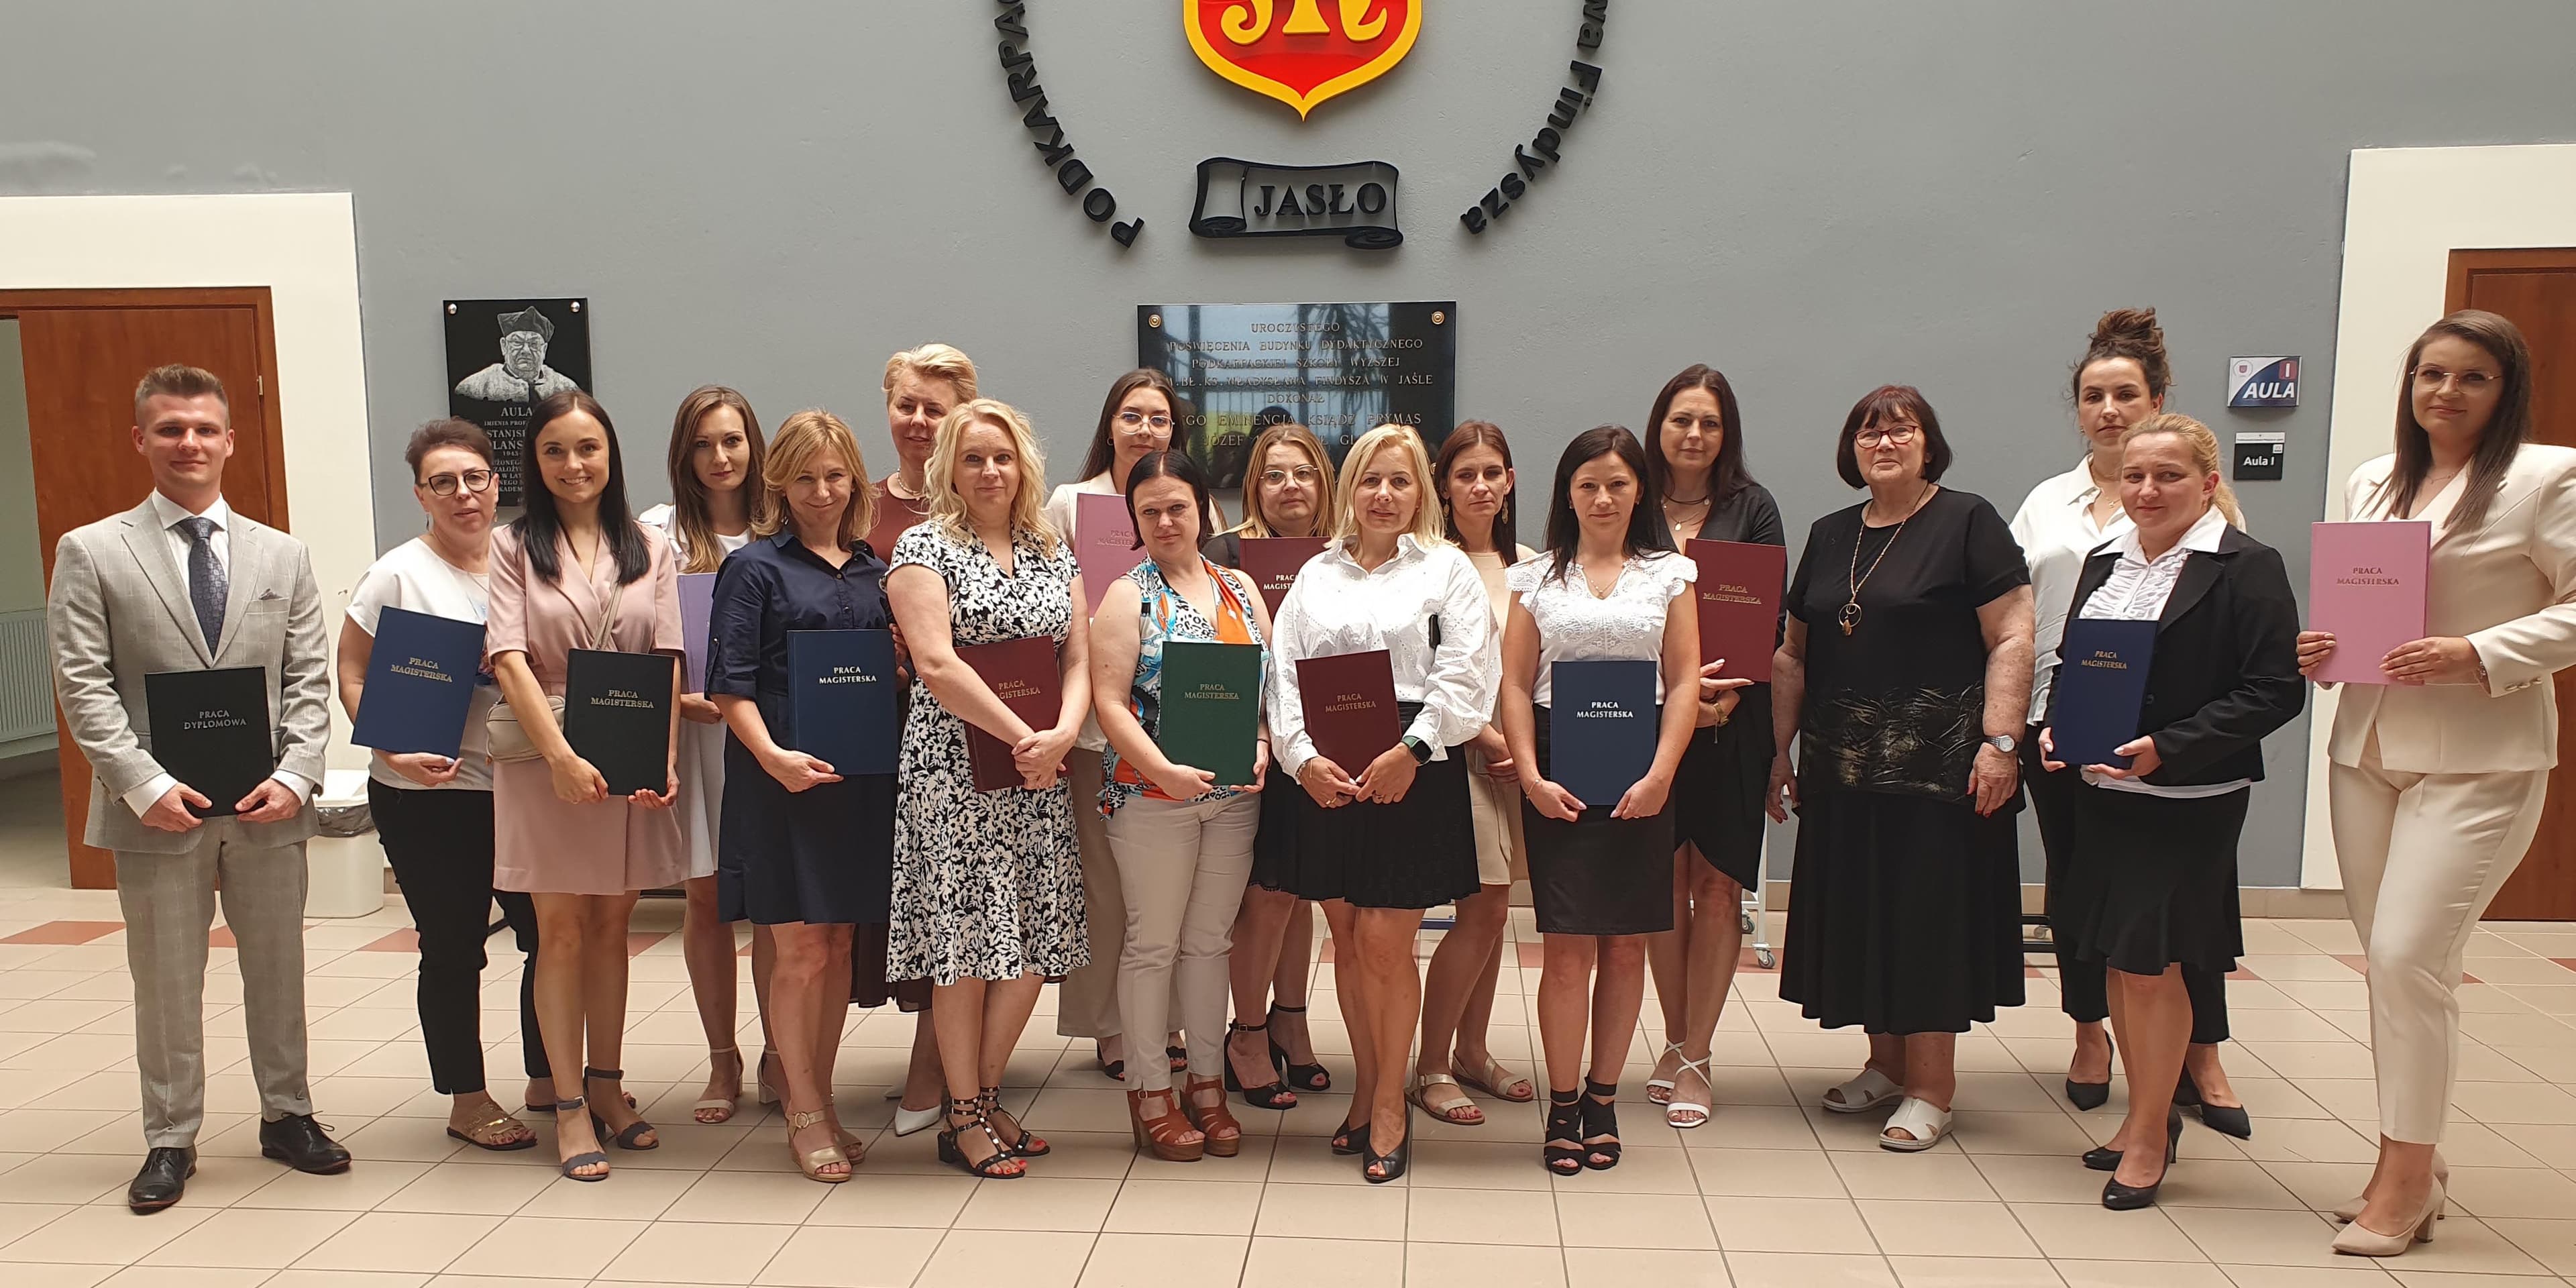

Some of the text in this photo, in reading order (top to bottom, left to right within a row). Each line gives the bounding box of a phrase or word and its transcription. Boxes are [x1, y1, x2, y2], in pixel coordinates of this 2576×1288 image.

[994, 0, 1144, 248] PODKARPA
[1460, 60, 1603, 234] Findysza
[1254, 182, 1387, 216] JASŁO
[1251, 323, 1340, 333] UROCZYSTEGO
[1260, 341, 1312, 352] BUDYNKU
[1321, 339, 1423, 350] DYDAKTYCZNEGO
[1316, 375, 1370, 386] FINDYSZA
[1380, 374, 1389, 385] W
[1398, 372, 1433, 385] JAŚLE
[2243, 382, 2295, 399] AULA
[1267, 392, 1326, 404] DOKONAŁ
[500, 407, 533, 417] AULA
[1307, 413, 1356, 428] KSIĄDZ
[1367, 413, 1421, 425] PRYMAS
[2243, 455, 2268, 466] Aula
[1263, 582, 1291, 590] MAGIST
[1719, 584, 1748, 594] PRACA
[2094, 650, 2118, 659] PRACA
[409, 657, 439, 669] PRACA
[2081, 659, 2128, 669] MAGISTERSKA
[390, 664, 453, 682] MAGISTERSKA
[834, 666, 861, 674] PRACA
[818, 675, 877, 684] MAGISTERSKA
[998, 680, 1025, 690] PRACA
[1199, 683, 1225, 691] PRACA
[608, 689, 639, 699] PRACA
[999, 686, 1041, 699] GISTERSKA
[1184, 692, 1240, 700] MAGISTERSKA
[1336, 692, 1362, 702] PRACA
[591, 697, 655, 709] MAGISTERSKA
[1325, 700, 1377, 713] MAGISTERSKA
[199, 710, 230, 719] PRACA
[1576, 710, 1634, 718] MAGISTERSKA
[183, 718, 247, 730] DYPLOMOWA
